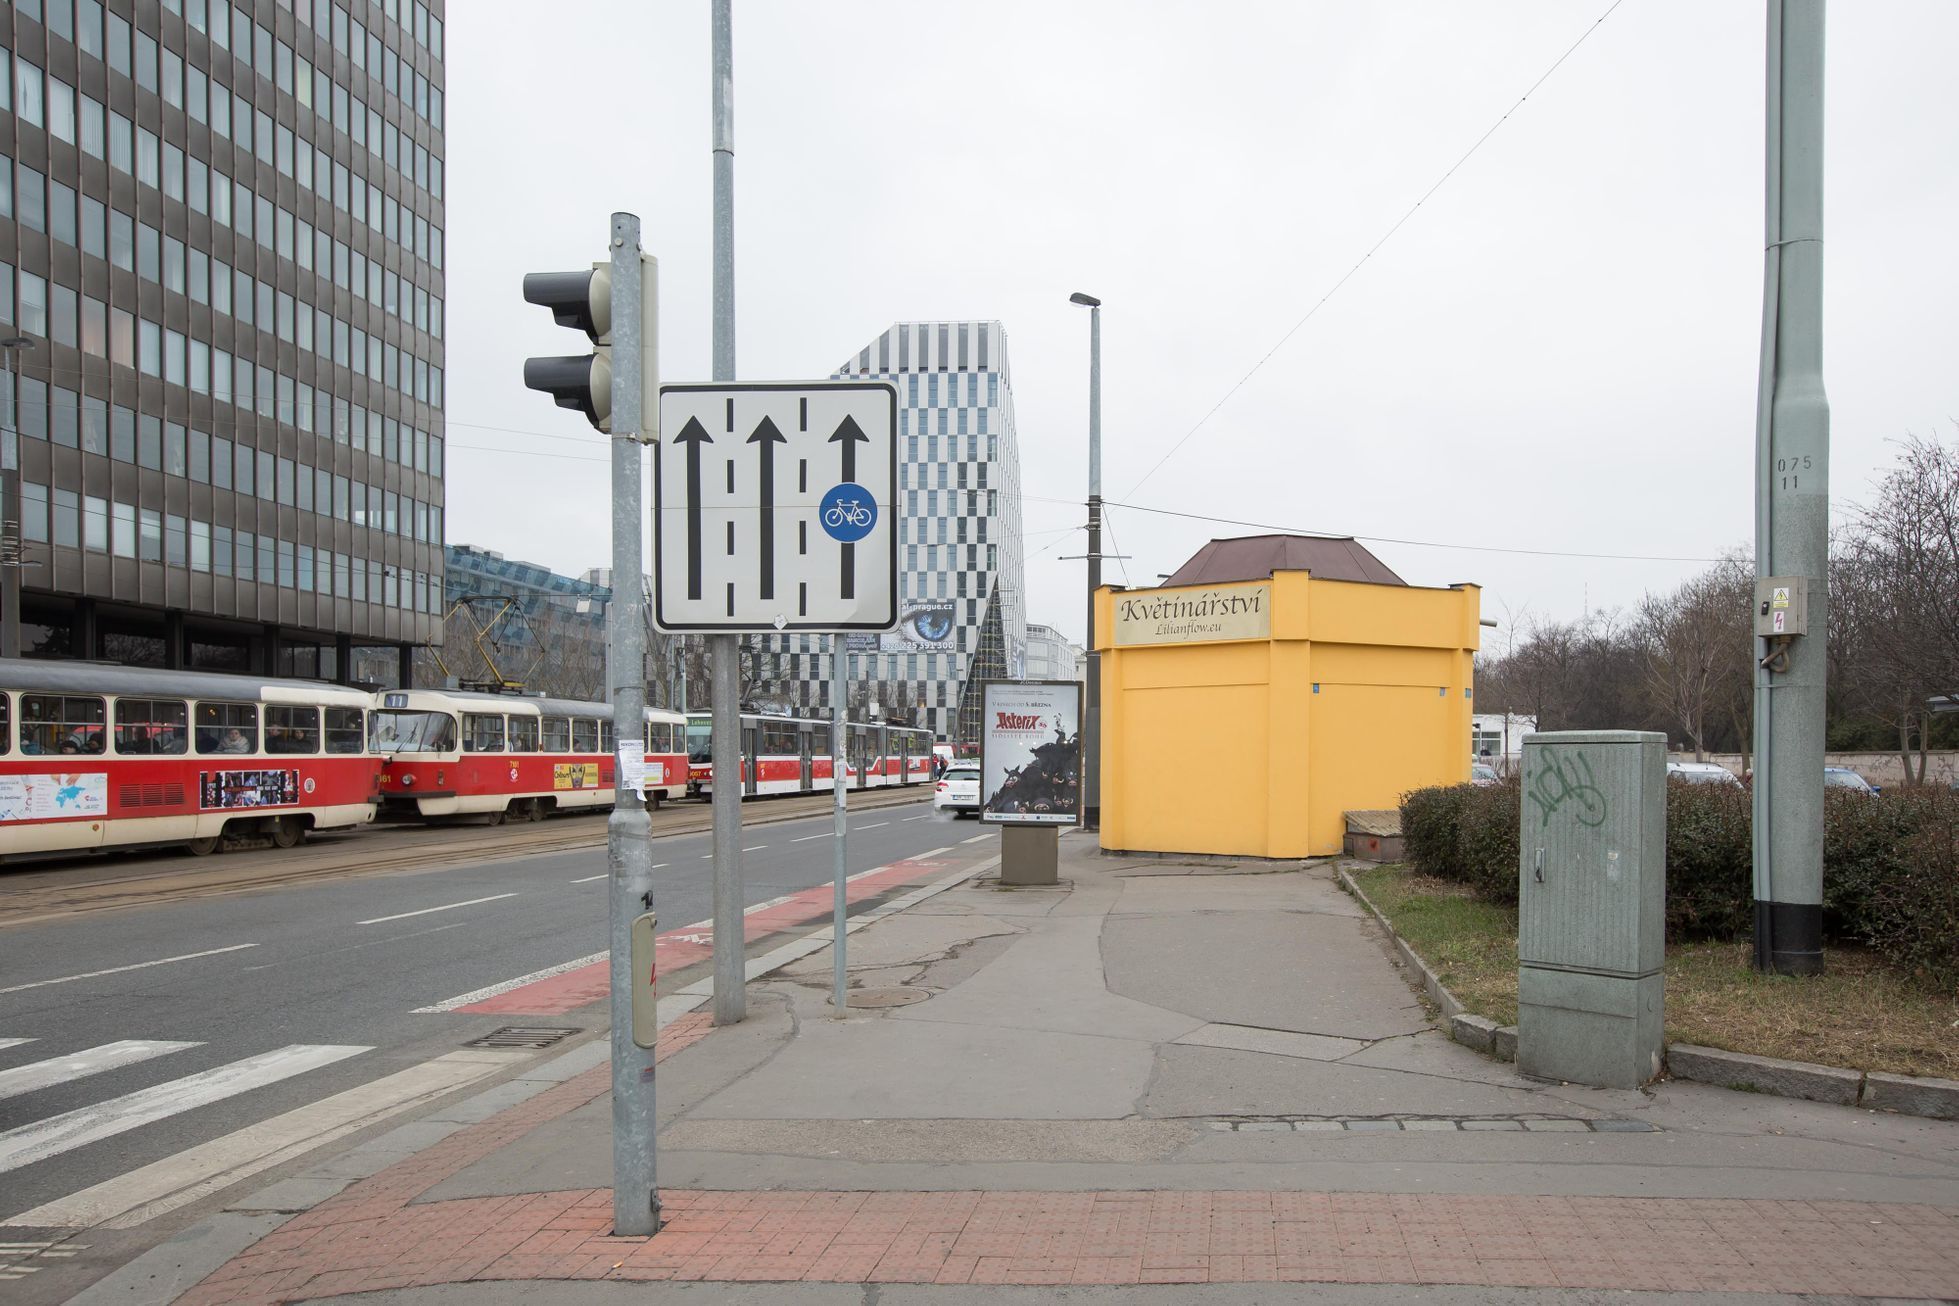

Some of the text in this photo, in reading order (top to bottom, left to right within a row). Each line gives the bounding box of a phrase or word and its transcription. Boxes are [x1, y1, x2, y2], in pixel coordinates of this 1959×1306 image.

[1778, 456, 1811, 472] 075
[1781, 475, 1797, 490] 11
[1120, 588, 1263, 622] Květinářství
[919, 641, 935, 649] 391
[937, 641, 954, 649] 300
[392, 695, 403, 707] 11
[996, 712, 1040, 729] Asterix
